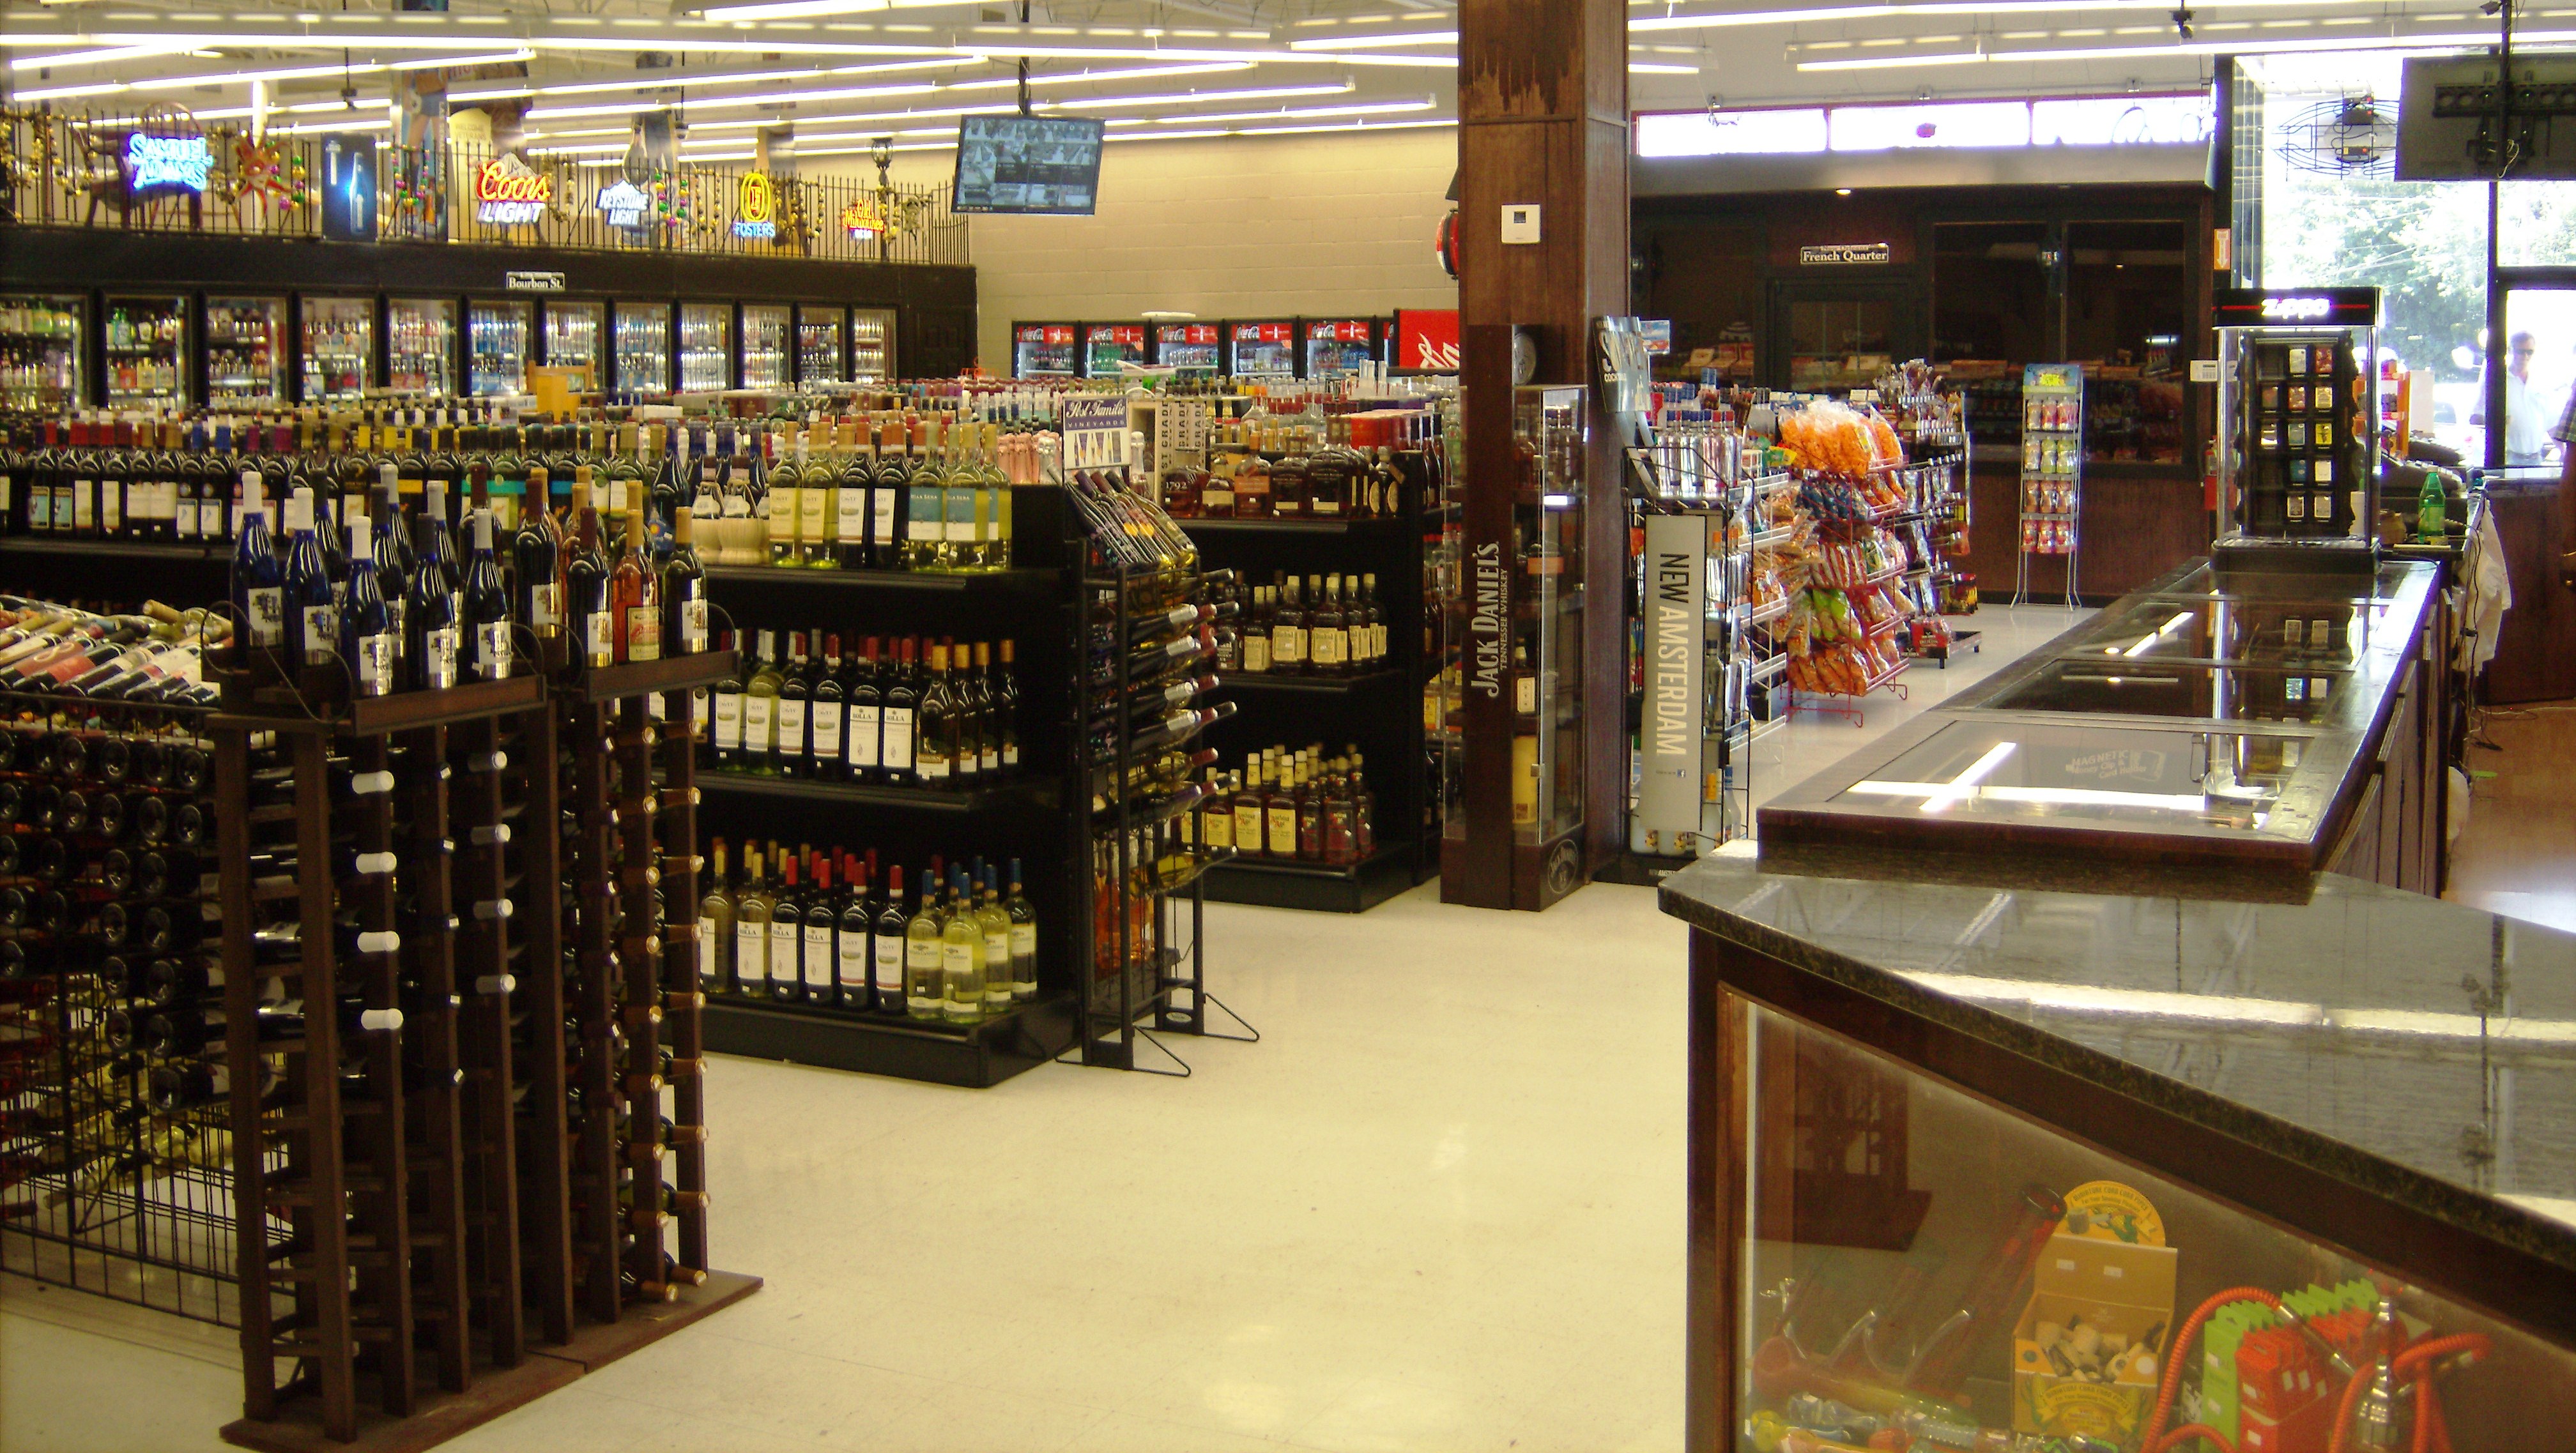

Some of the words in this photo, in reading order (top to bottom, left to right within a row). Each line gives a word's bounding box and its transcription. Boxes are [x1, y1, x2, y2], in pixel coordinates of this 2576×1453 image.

[478, 160, 551, 201] Coors
[598, 189, 648, 210] KEYSTONE
[480, 202, 546, 223] LIGHT
[610, 209, 639, 224] LIGHT
[1803, 250, 1840, 262] French
[1843, 250, 1887, 262] Quarter
[509, 277, 548, 289] Bourbon
[1068, 420, 1125, 428] VINEYARDS
[1166, 481, 1188, 491] 1792
[1471, 542, 1499, 632] DANIEL'S
[1660, 553, 1689, 603] NEW
[1471, 639, 1499, 697] JACK
[1657, 605, 1689, 756] AMSTERDAM
[2072, 750, 2129, 766] MAGNETIC
